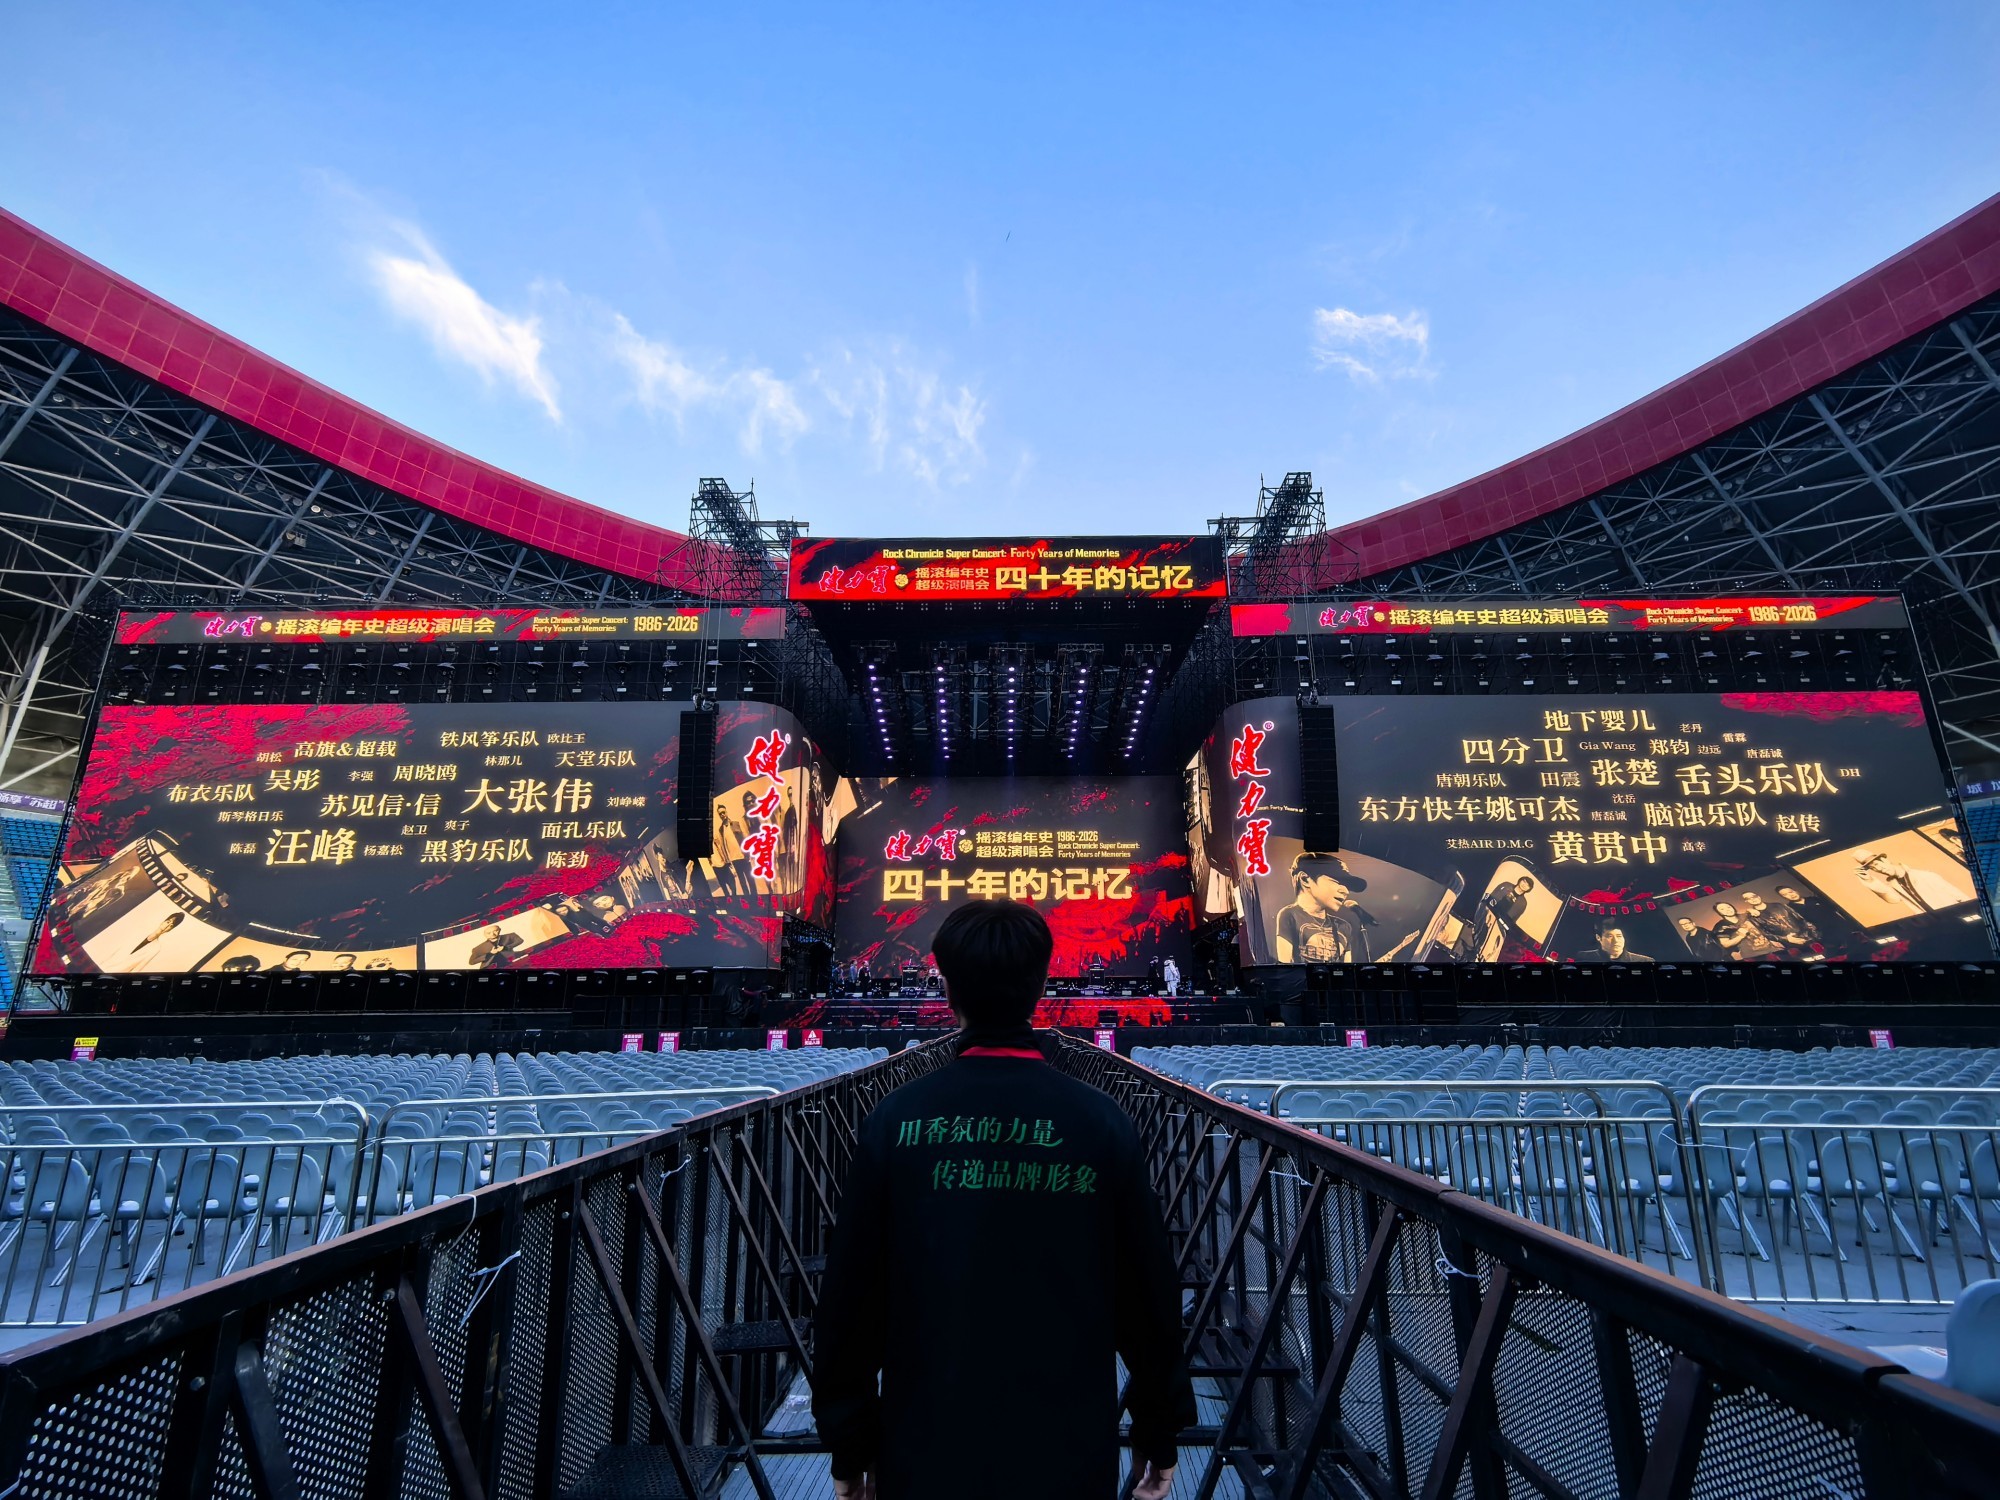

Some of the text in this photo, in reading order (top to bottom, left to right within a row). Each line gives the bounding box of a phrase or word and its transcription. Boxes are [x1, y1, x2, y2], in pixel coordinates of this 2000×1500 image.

[883, 548, 1119, 559] Rock Chronicle Super Concert: Forty Years of Memories
[916, 568, 988, 578] 摇滚编年史
[996, 566, 1193, 590] 四十年的记忆
[916, 580, 989, 590] 超级演唱会
[1389, 608, 1608, 625] 摇滚编年史超级演唱会
[1645, 607, 1663, 615] Rock
[1663, 607, 1693, 615] Chronicle
[1695, 607, 1715, 616] Super
[1648, 614, 1734, 624] Forty Years of Memories
[1748, 606, 1816, 622] 1986-2026
[275, 617, 496, 634] 摇滚编年史超级演唱会
[532, 624, 617, 633] Forty Years of Memories
[533, 616, 549, 624] Rock
[550, 616, 580, 624] Chronicle
[581, 616, 600, 626] Super
[634, 616, 698, 631] 1986-2026
[1544, 710, 1656, 731] 地下婴儿
[1680, 724, 1702, 732] 老丹
[440, 731, 539, 747] 铁风筝乐队
[547, 733, 585, 743] 欧比王
[294, 741, 397, 757] 高旗&超载
[1463, 737, 1568, 764] 四分卫
[1602, 742, 1636, 751] Wang
[1650, 739, 1689, 755] 郑钧
[1698, 745, 1721, 754] 边远
[256, 752, 282, 762] 胡松
[485, 756, 522, 766] 林那儿
[555, 750, 636, 767] 天堂乐队
[264, 769, 320, 791] 吴彤
[349, 771, 373, 781] 李强
[393, 764, 457, 781] 周晓鸥
[1437, 773, 1506, 787] 唐朝乐队
[1541, 771, 1580, 787] 田震
[1591, 759, 1660, 786] 张楚
[1675, 763, 1838, 795] 舌头乐队
[167, 784, 255, 802] 布衣乐队
[461, 778, 593, 813] 大张伟
[320, 793, 441, 816] 苏见信·信
[1359, 796, 1580, 821] 东方快车姚可杰
[218, 811, 283, 822] 斯琴格日乐
[1644, 802, 1767, 826] 脑浊乐队
[401, 825, 427, 835] 赵卫
[445, 820, 469, 830] 爽子
[542, 821, 626, 839] 面孔乐队
[1776, 814, 1820, 832] 赵传
[976, 831, 1053, 844] 摇滚编年史
[1057, 831, 1098, 843] 1986-2026
[1446, 839, 1533, 848] 艾热AIR D.M.G
[230, 843, 256, 854] 陈磊
[265, 828, 357, 865] 汪峰
[364, 845, 403, 856] 杨嘉松
[421, 839, 533, 862] 黑豹乐队
[976, 843, 1054, 857] 超级演唱会
[1057, 842, 1071, 850] Rock
[1099, 842, 1116, 850] Super
[1548, 831, 1667, 863] 黄贯中
[546, 851, 589, 868] 陈劲
[1058, 850, 1075, 859] Forty
[883, 868, 1132, 901] 四十年的记忆
[896, 1115, 1063, 1147] 用香氛的力量
[932, 1159, 1097, 1193] 传递品牌形象
